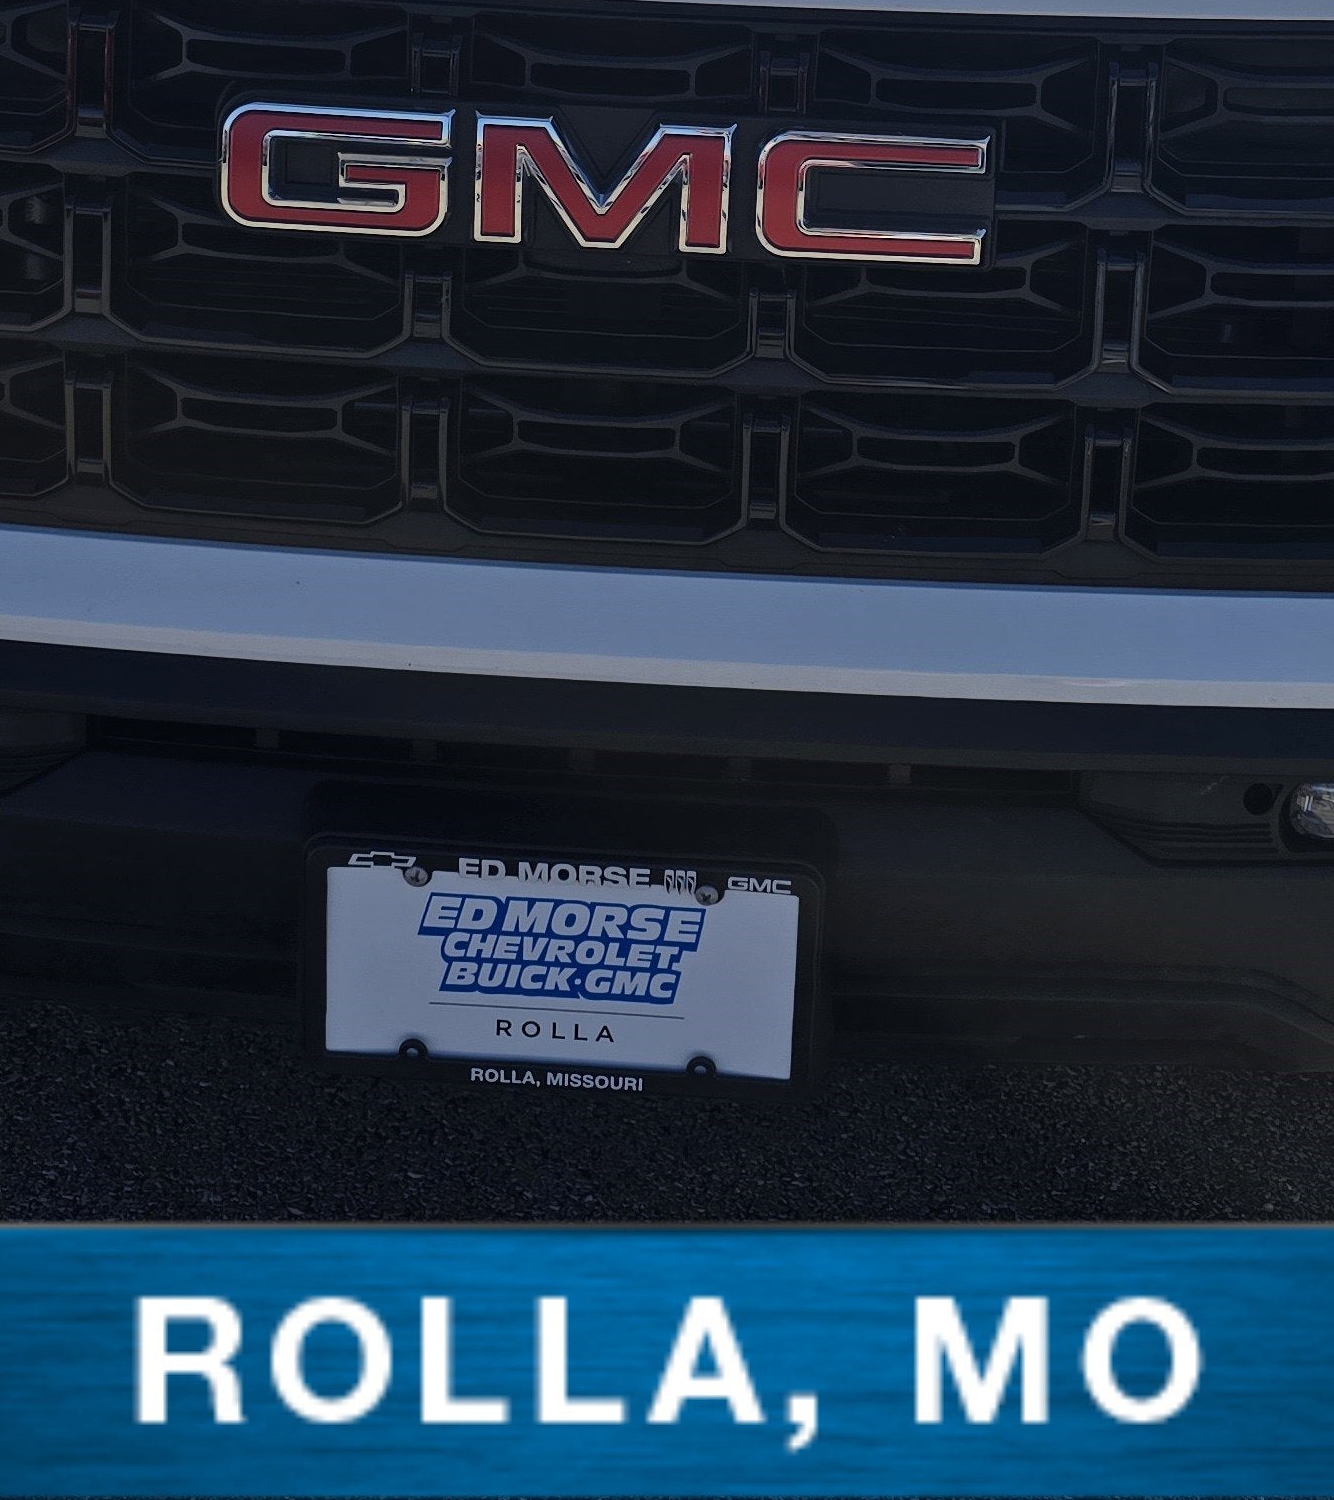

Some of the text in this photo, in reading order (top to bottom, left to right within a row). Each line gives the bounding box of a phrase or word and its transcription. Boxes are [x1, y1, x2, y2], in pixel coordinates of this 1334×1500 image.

[220, 100, 992, 267] GMC
[458, 857, 651, 888] ED MORSE
[726, 875, 793, 896] GMC
[422, 895, 703, 943] ED MORSE
[443, 931, 680, 970] CHEVROLET
[495, 1018, 615, 1044] ROLLA
[470, 1067, 644, 1092] ROLLA, MISSOURI
